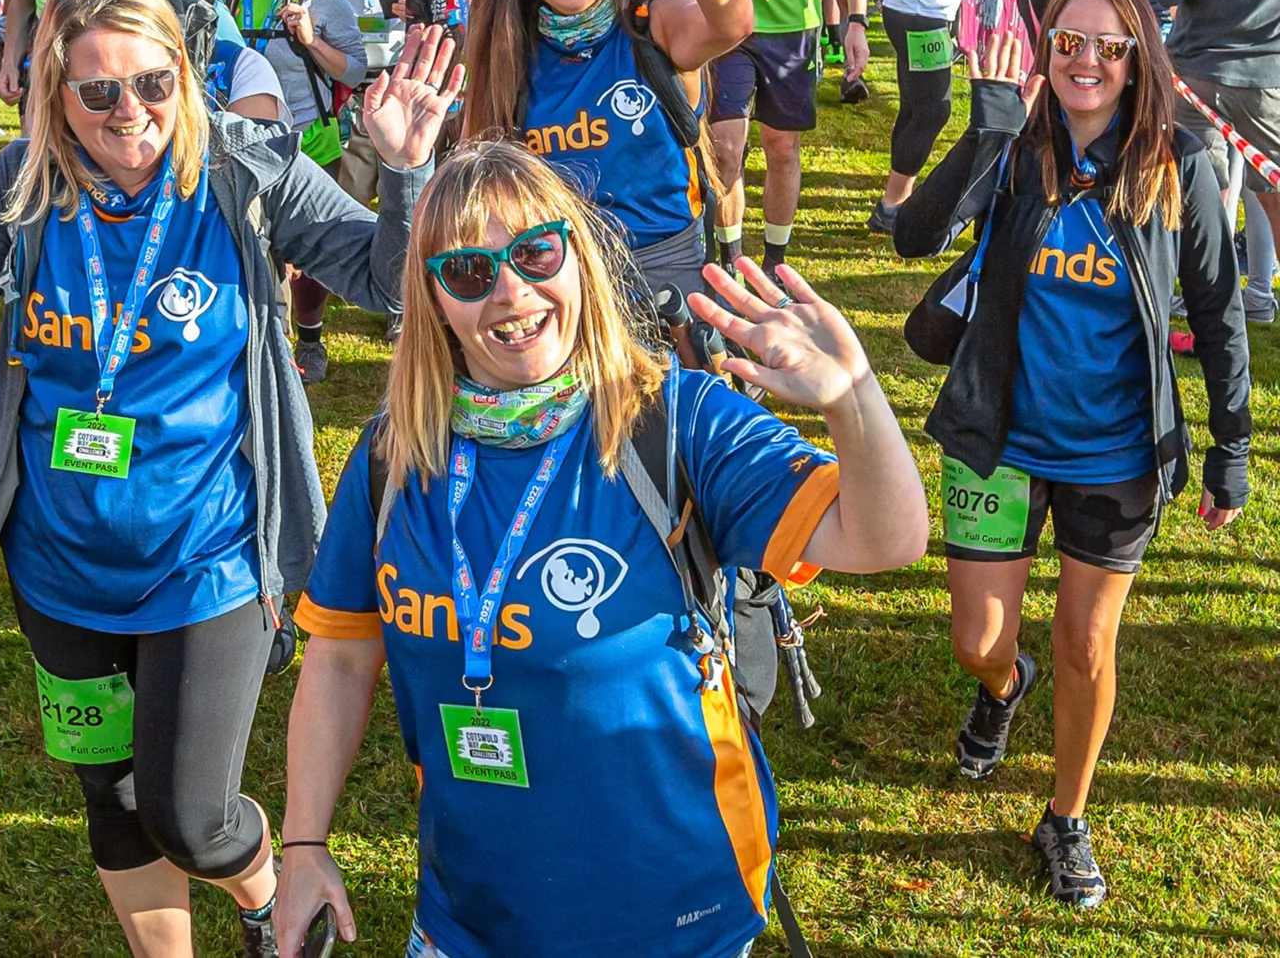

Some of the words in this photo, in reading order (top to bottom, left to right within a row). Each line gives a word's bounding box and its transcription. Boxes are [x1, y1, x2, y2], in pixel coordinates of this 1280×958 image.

[920, 42, 946, 55] 1001
[525, 111, 610, 154] ands
[84, 180, 110, 206] ands
[143, 246, 154, 264] 2022
[1029, 243, 1116, 286] nds
[24, 291, 152, 354] Sans
[115, 333, 127, 354] 2022
[87, 421, 107, 431] 2022
[77, 432, 110, 444] COTSWOLD
[64, 459, 95, 471] EVENT
[95, 463, 119, 474] PASS
[453, 480, 465, 505] 2022
[524, 485, 542, 508] 2022
[947, 486, 1000, 515] 2076
[957, 513, 978, 523] Sands
[964, 532, 980, 541] Full
[981, 534, 1003, 544] Cont.
[1005, 537, 1019, 545] (W)
[376, 563, 533, 651] Sans
[478, 599, 491, 624] 2022
[41, 693, 104, 727] 2128
[56, 726, 81, 736] Sands
[470, 717, 491, 727] 2022
[466, 731, 499, 744] COTSWOLD
[70, 746, 89, 755] Full
[121, 743, 133, 753] (W
[463, 766, 493, 779] EVENT
[493, 769, 518, 782] PASS
[676, 909, 700, 927] MAX
